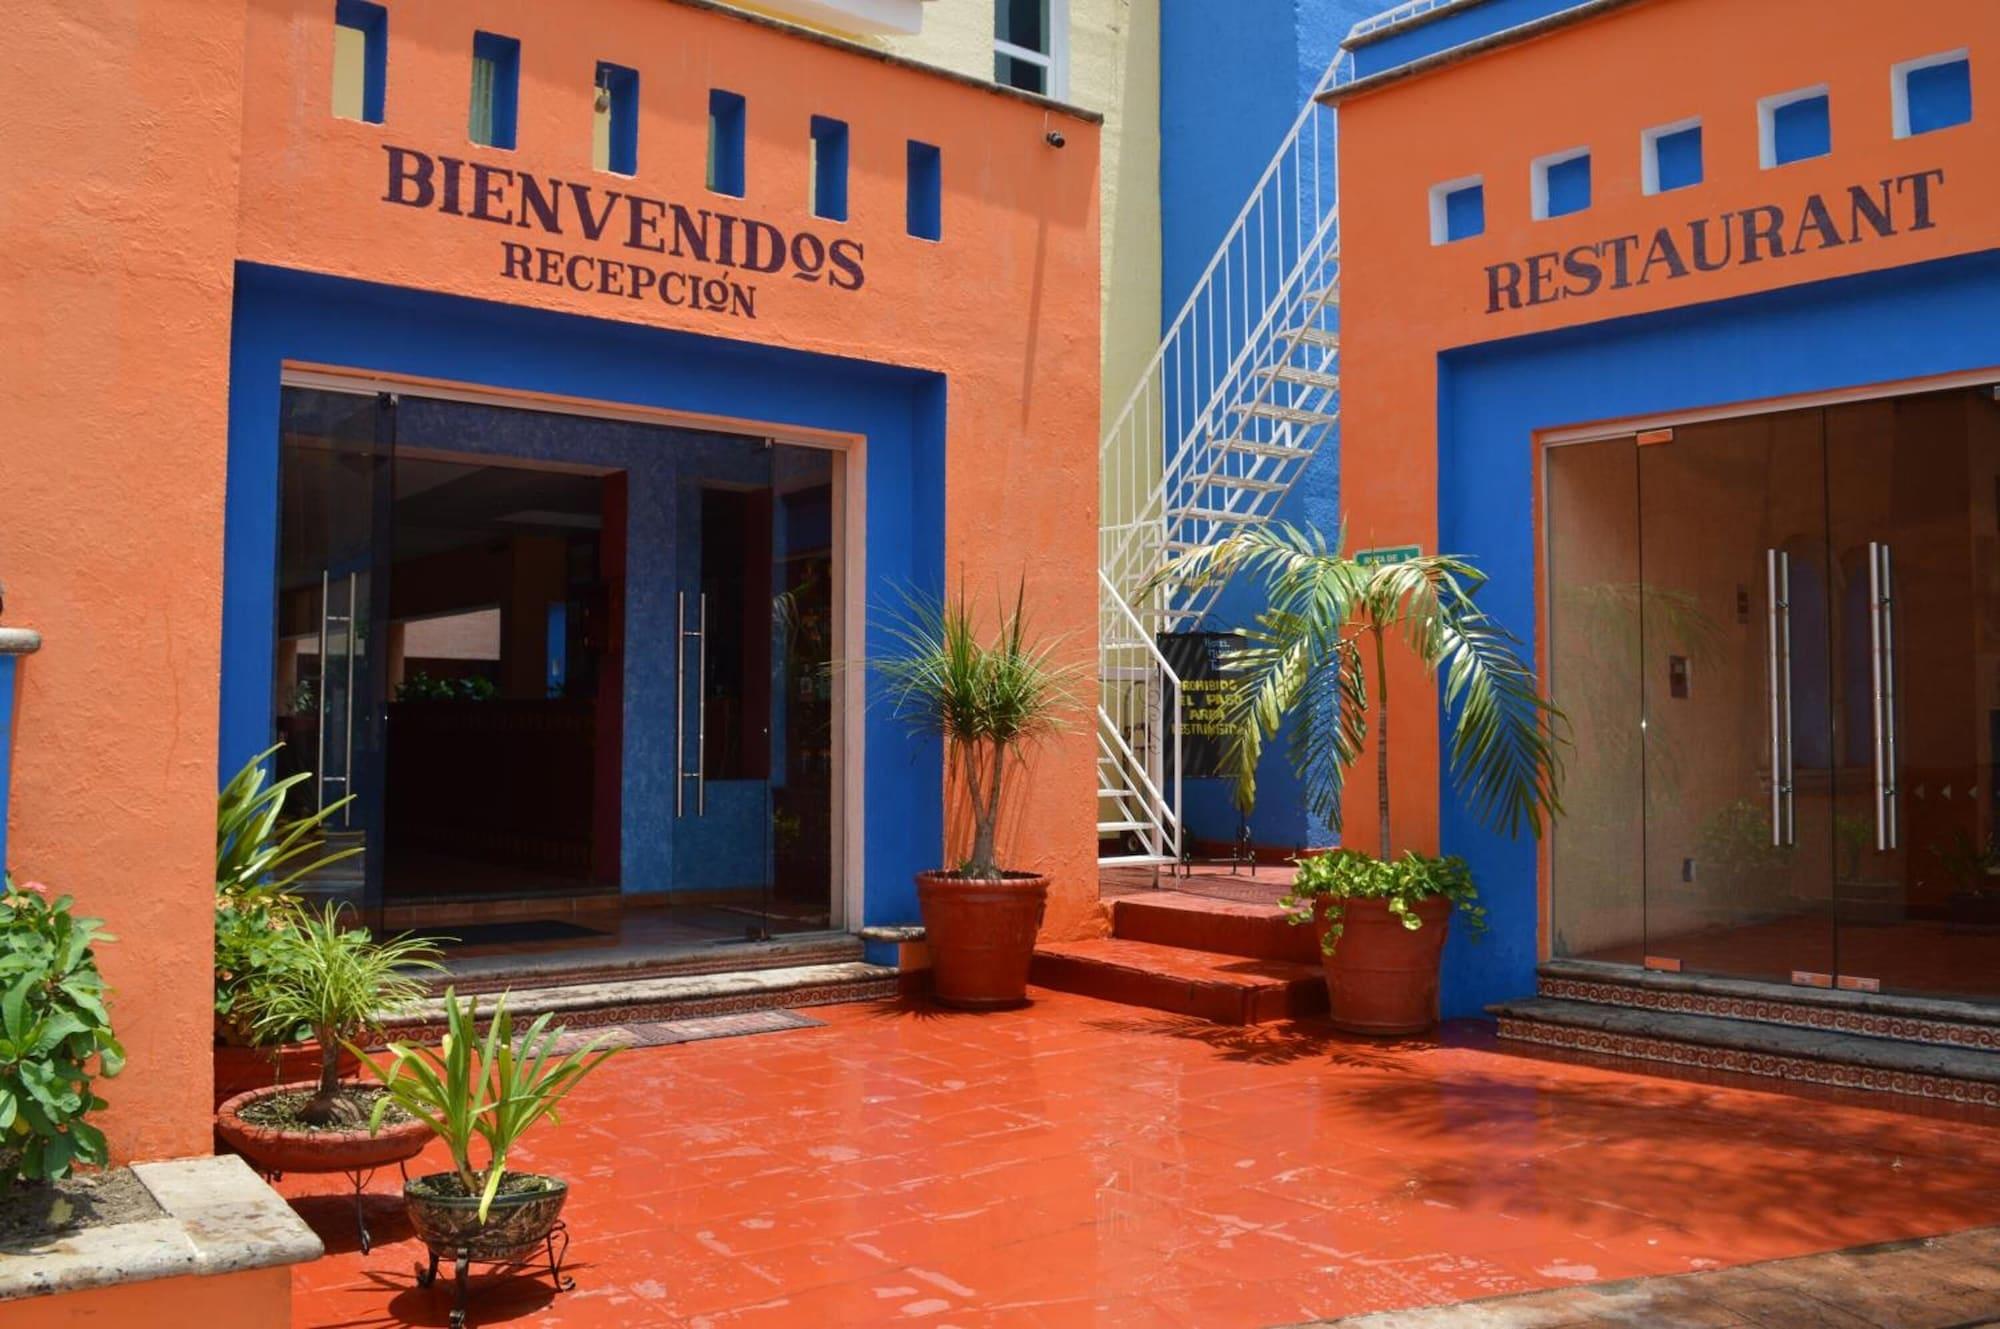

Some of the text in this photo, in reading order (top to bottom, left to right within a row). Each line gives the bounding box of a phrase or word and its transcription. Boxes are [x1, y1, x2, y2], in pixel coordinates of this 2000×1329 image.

[380, 143, 866, 292] BIENVENIDOS
[1484, 168, 1944, 314] RESTAURANT
[500, 241, 757, 319] RECEPCIÓN
[1179, 679, 1238, 691] ROHIBIDO
[1171, 723, 1245, 736] ESTRINGI
